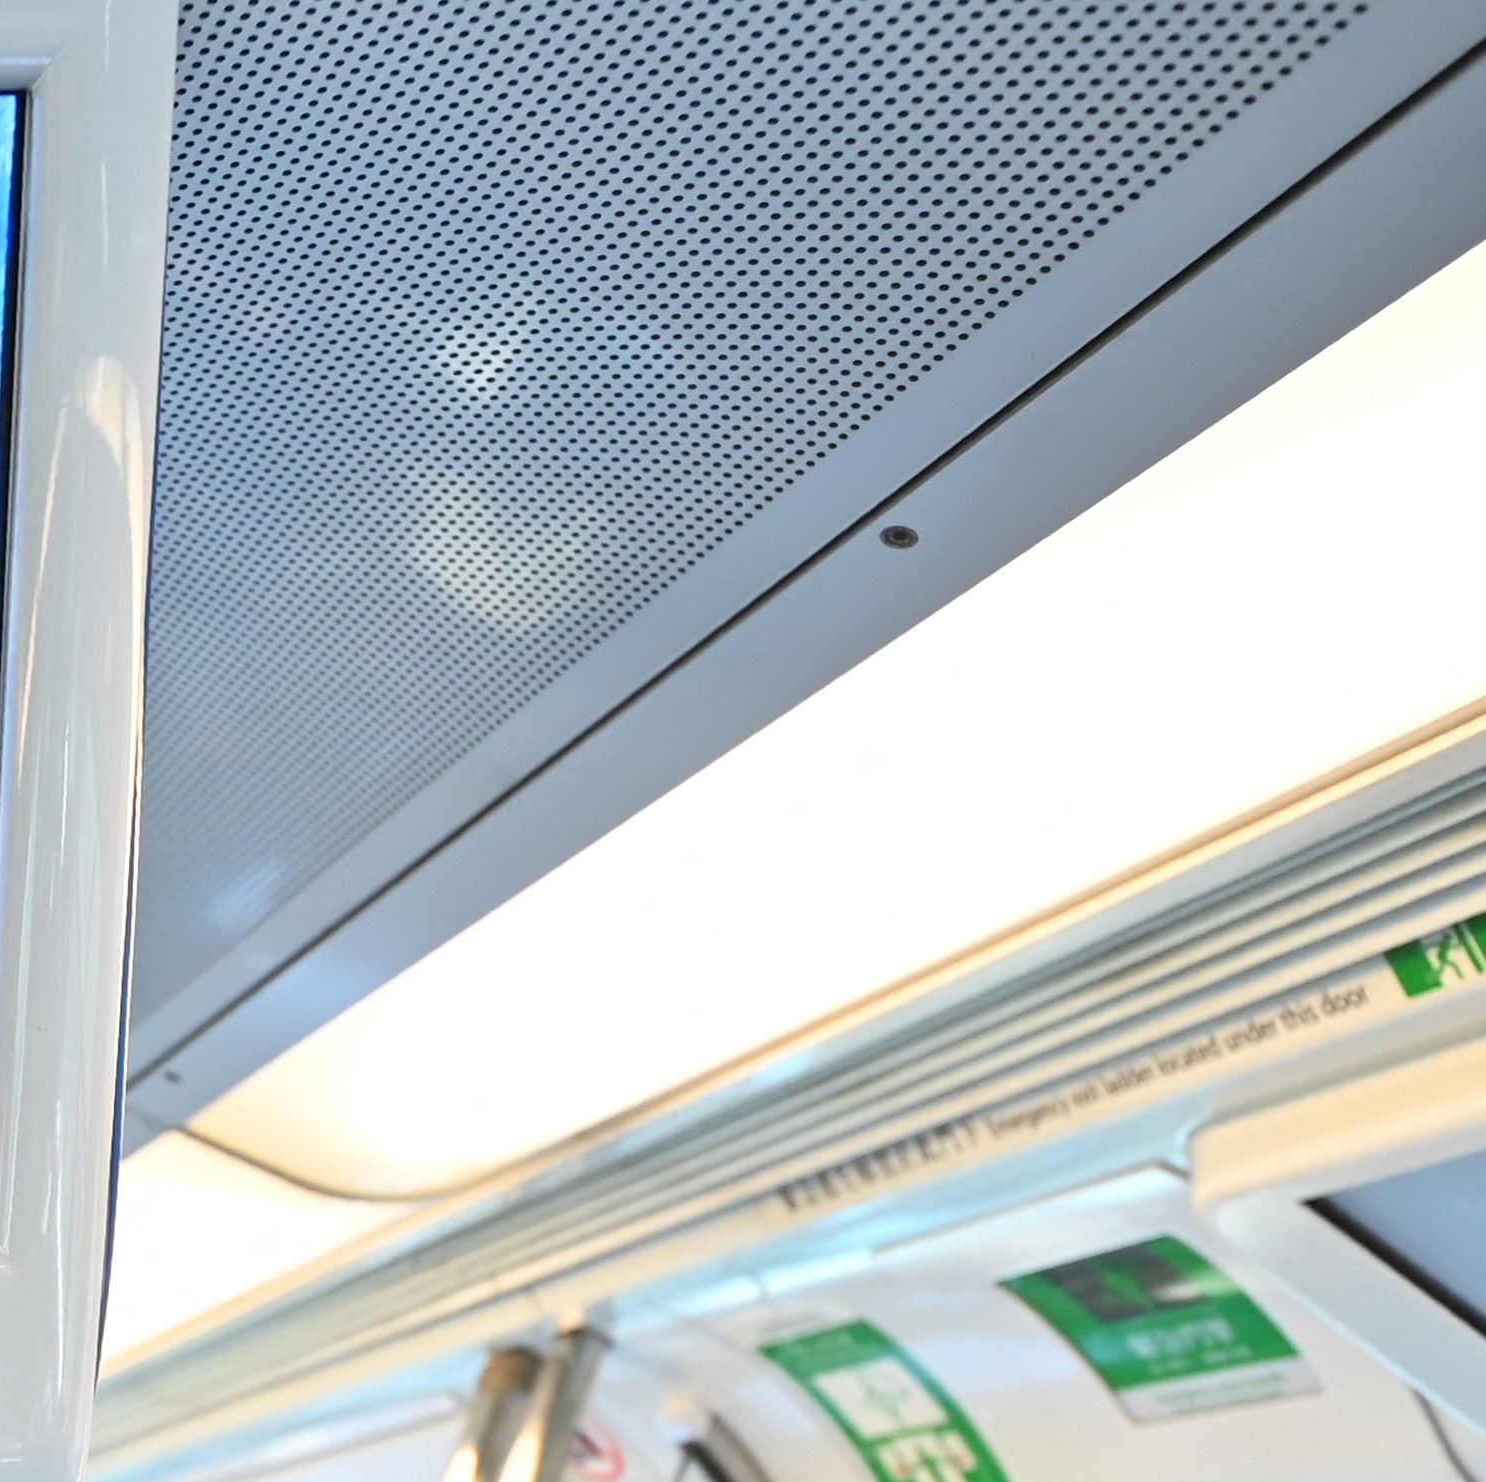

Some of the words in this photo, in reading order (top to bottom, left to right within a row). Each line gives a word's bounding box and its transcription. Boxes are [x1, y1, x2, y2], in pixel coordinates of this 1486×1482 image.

[1155, 1039, 1223, 1077] located
[1225, 1020, 1279, 1050] under
[1280, 1000, 1319, 1030] this
[1321, 986, 1370, 1016] door
